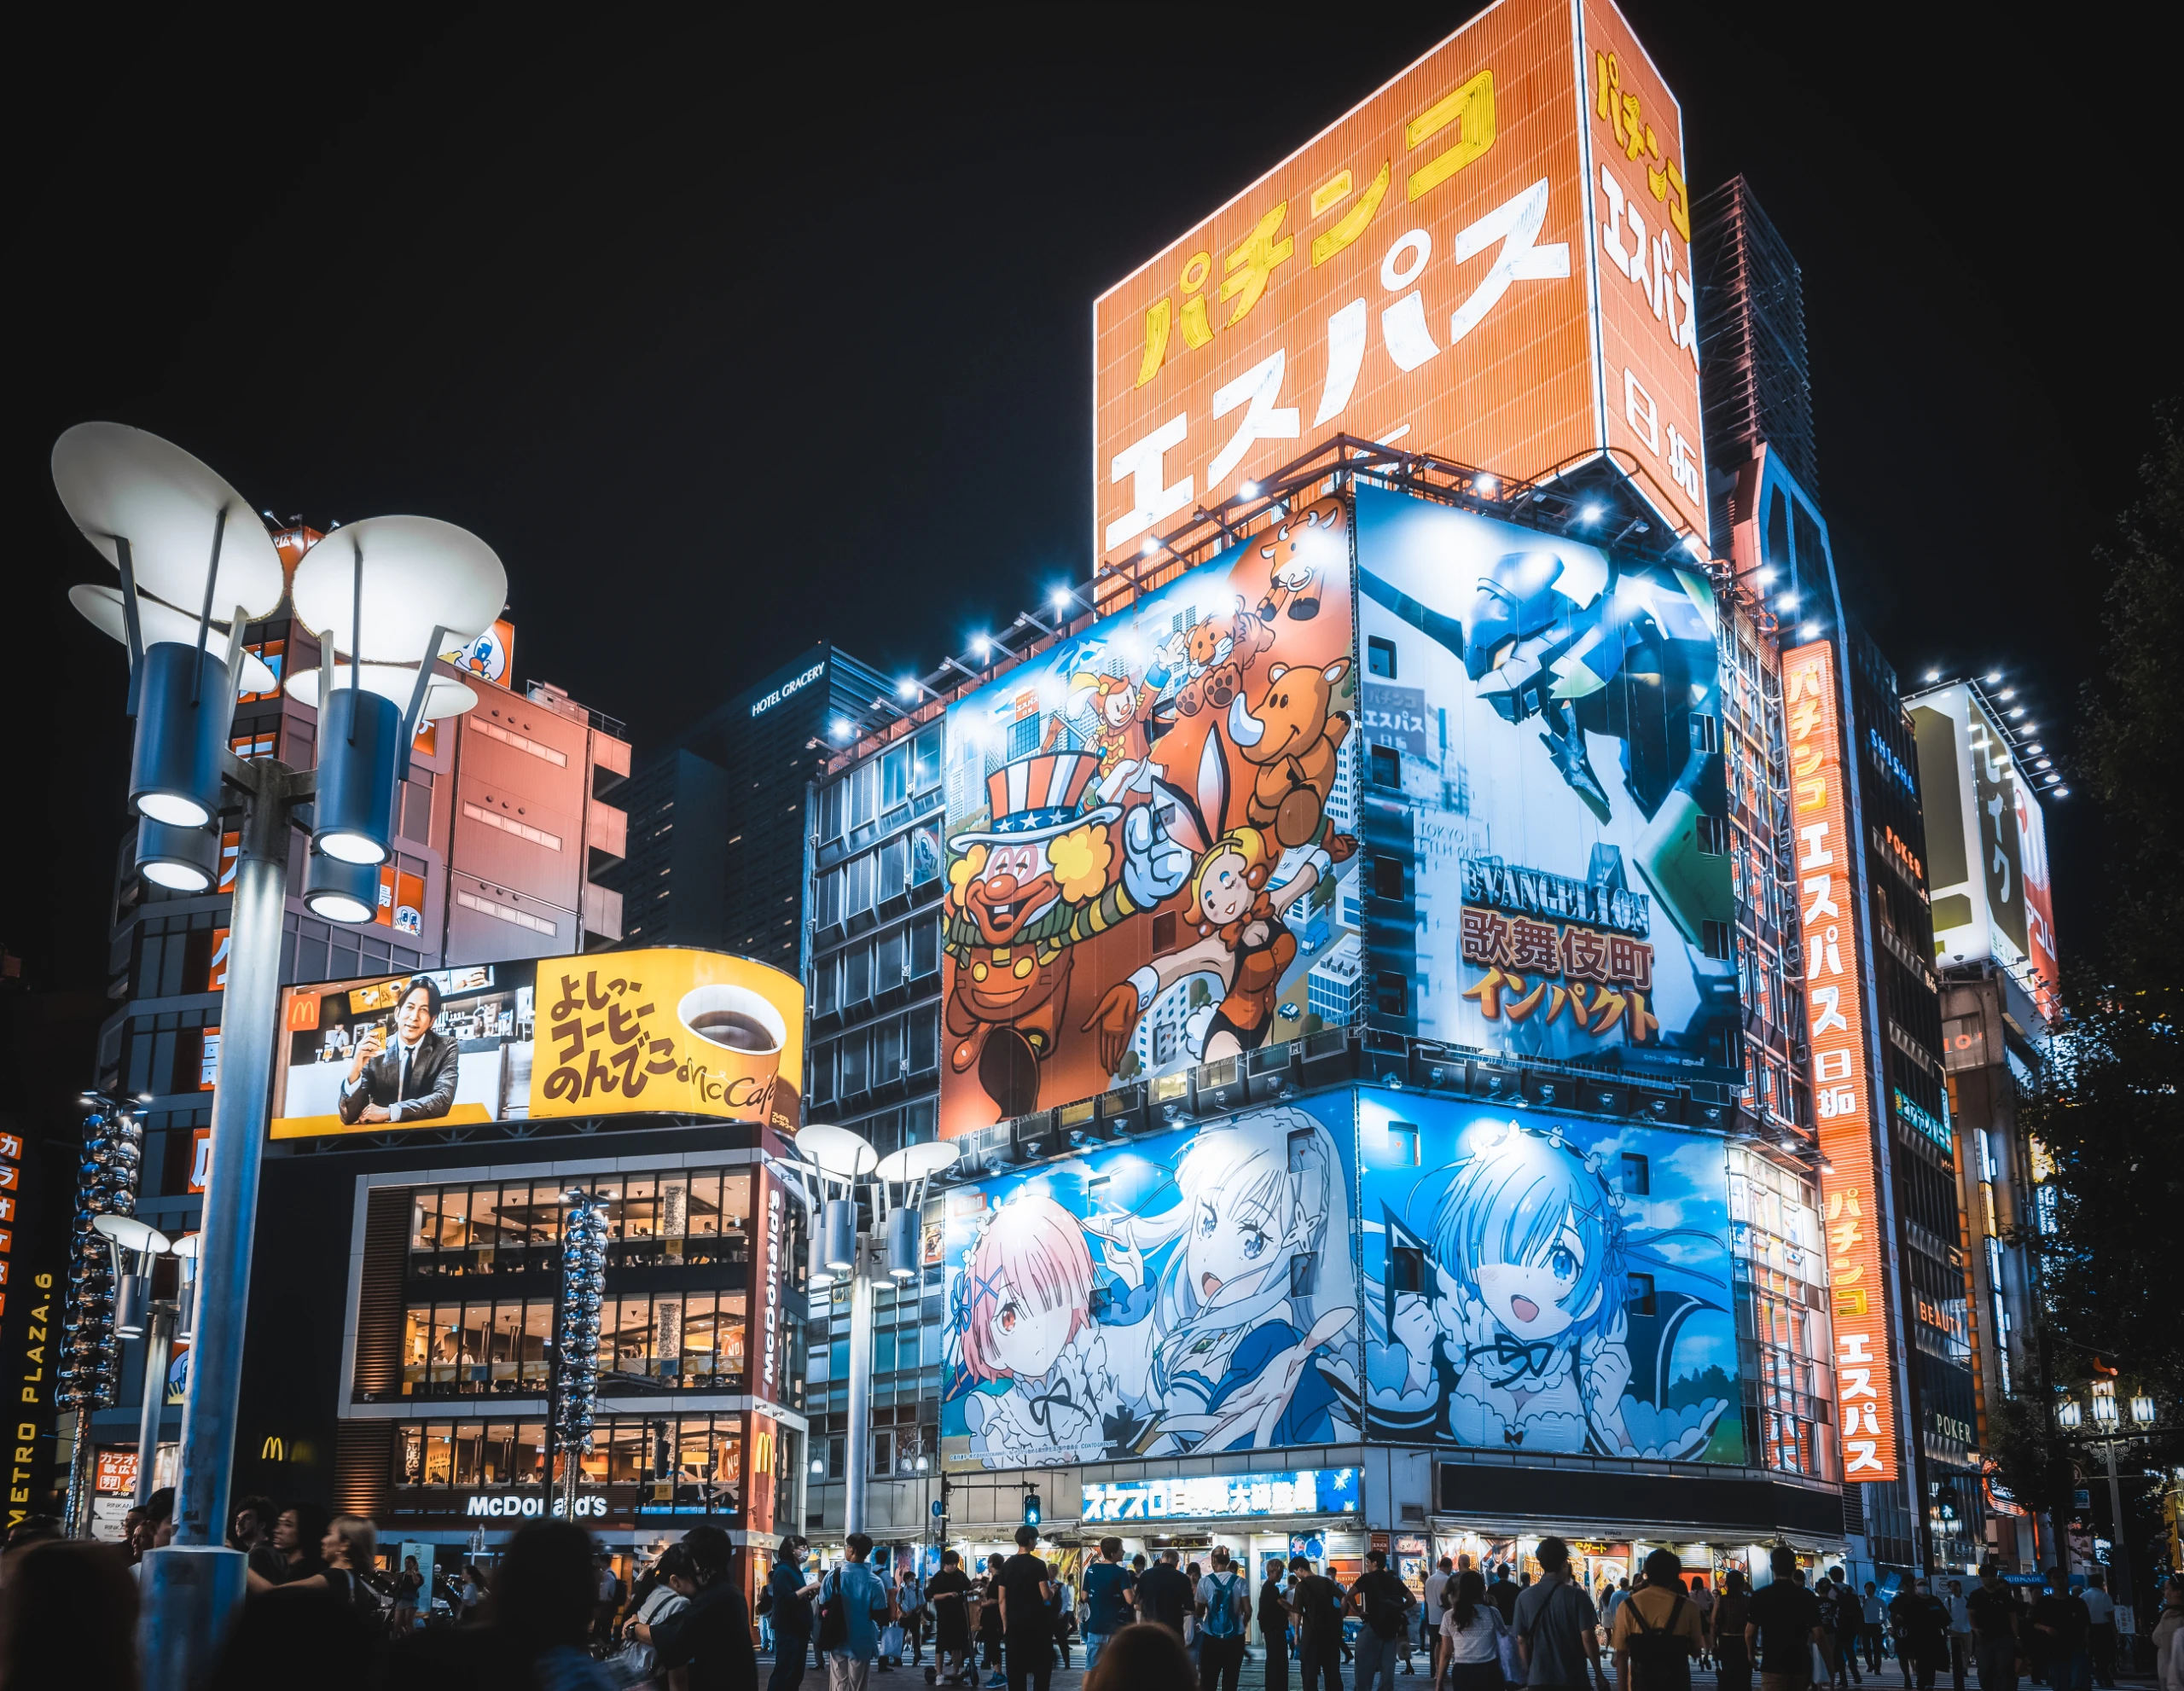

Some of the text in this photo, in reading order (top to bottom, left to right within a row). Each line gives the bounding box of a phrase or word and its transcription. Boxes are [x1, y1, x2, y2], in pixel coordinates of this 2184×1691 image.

[1596, 51, 1690, 242] パチンコ
[1136, 69, 1496, 389] パチンコ
[1601, 164, 1699, 374] エスパス
[1107, 176, 1571, 552] エスパス
[1624, 368, 1701, 507] 日拓
[752, 661, 824, 717] HOTEL GRACERY
[1365, 710, 1425, 734] エスパス
[1368, 688, 1417, 709] パチンコ
[1870, 728, 1915, 794] SHISHA
[1788, 661, 1856, 1119] パチンコ エスパス 日拓
[1885, 825, 1923, 880] POKER
[1461, 858, 1650, 938] EVANGELION
[1461, 907, 1653, 991] 歌舞伎町
[551, 1002, 655, 1066] コーヒー
[1461, 966, 1659, 1042] インパクト
[543, 1031, 678, 1104] のんでこ
[762, 1189, 781, 1385] McDonald's
[1920, 1301, 1962, 1339] BEAUTY
[1827, 1188, 1884, 1473] パチンコ エスパス
[8, 1273, 52, 1527] METRO PLAZA.6
[1937, 1413, 1972, 1444] POKER
[100, 1453, 138, 1465] カラオ
[467, 1496, 607, 1517] McDoad's
